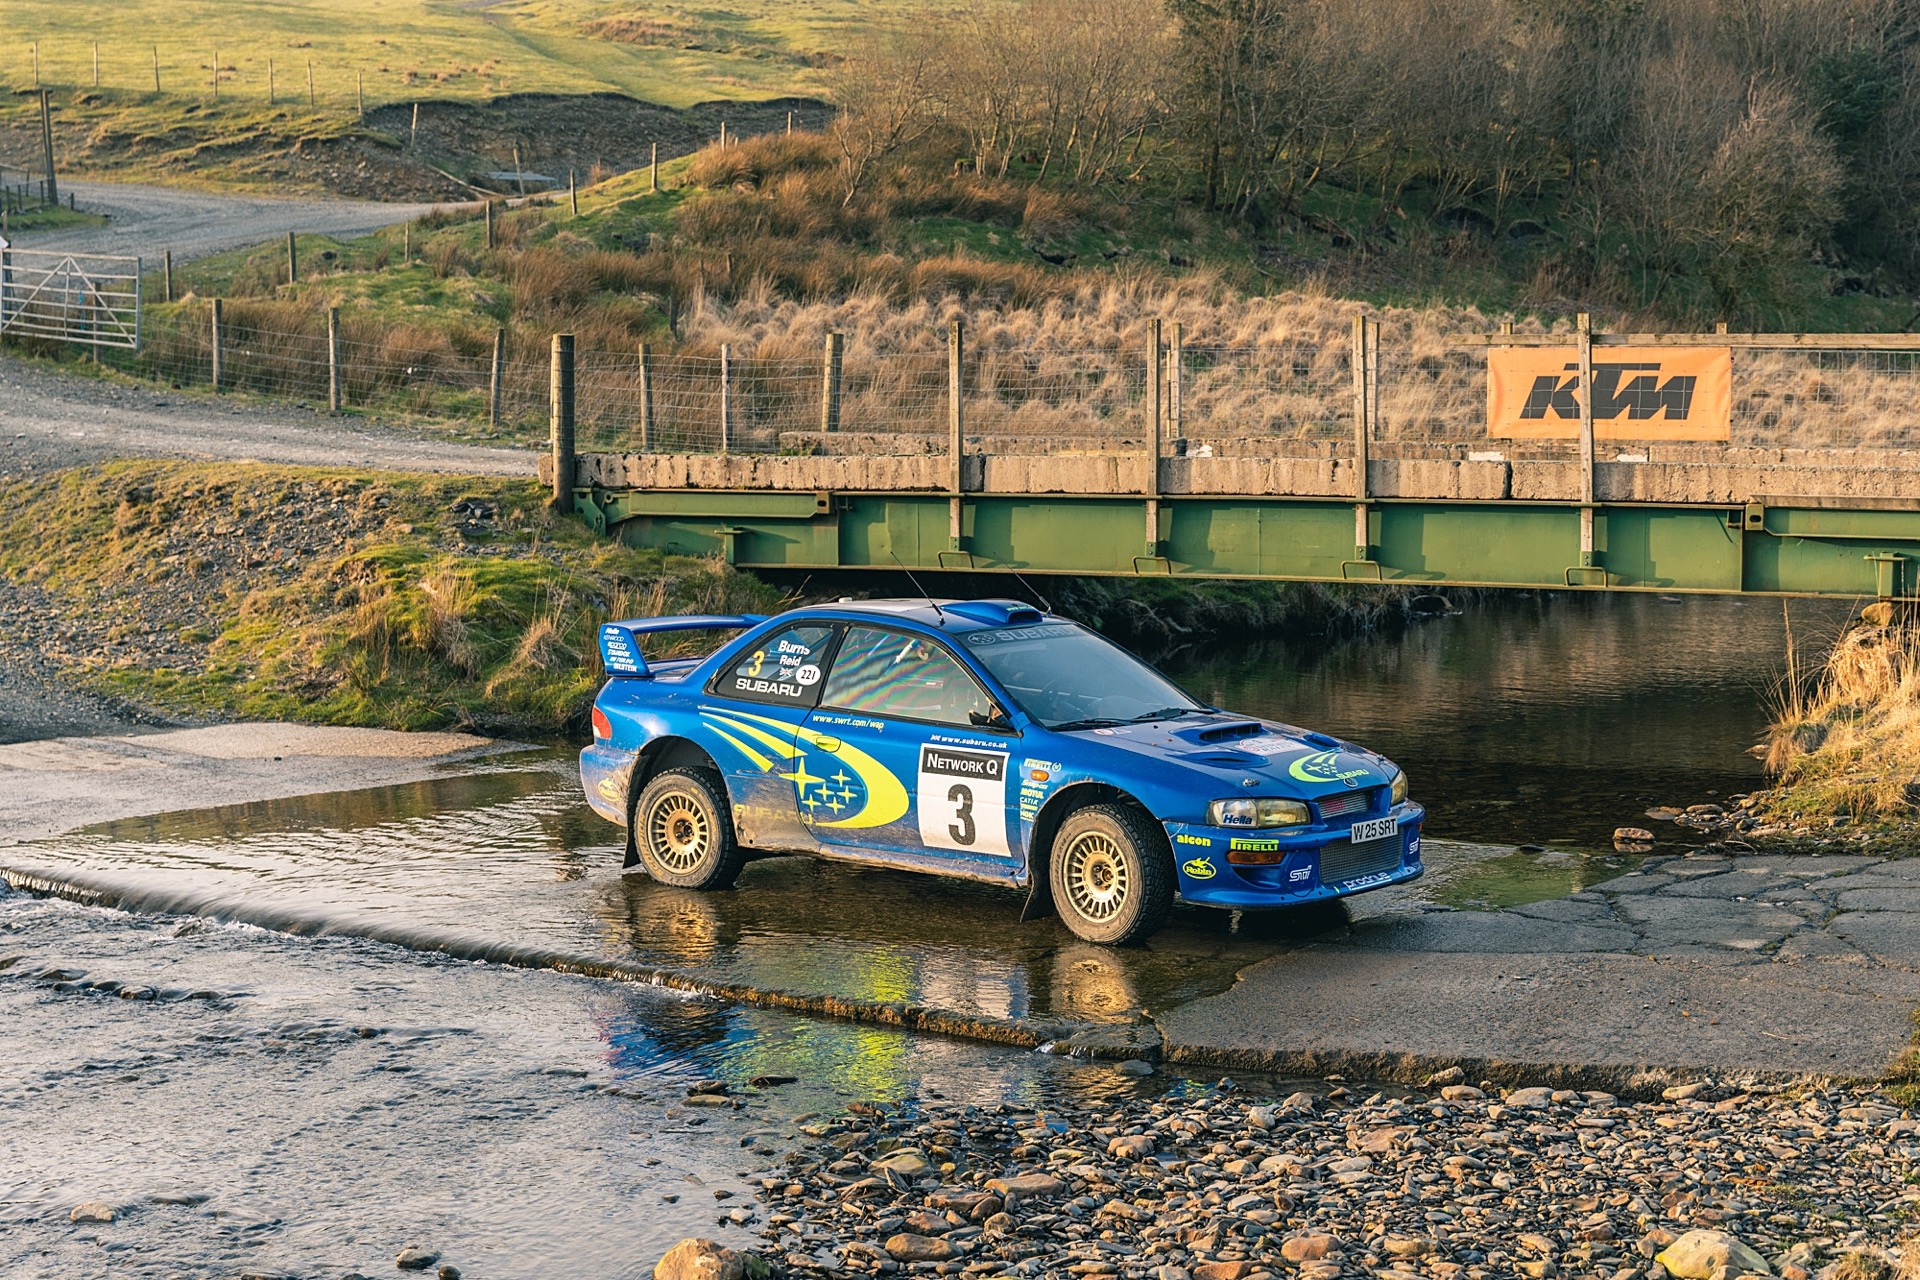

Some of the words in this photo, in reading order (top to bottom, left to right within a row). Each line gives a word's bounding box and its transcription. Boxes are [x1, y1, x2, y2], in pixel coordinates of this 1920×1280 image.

[1520, 363, 1697, 420] KTM
[995, 626, 1072, 641] SUBARU
[778, 640, 810, 655] Burns
[748, 650, 765, 677] 3
[779, 655, 802, 666] Reid
[801, 670, 816, 680] 221
[735, 678, 803, 697] SUBARU
[813, 715, 885, 730] www.swrt.com/wap
[941, 736, 1007, 748] www.subaru.co.uk
[986, 759, 998, 775] Q
[1023, 758, 1052, 770] PIRELLI
[1020, 788, 1044, 799] MOTUL
[948, 784, 976, 845] 3
[1223, 814, 1252, 825] Hella
[1353, 826, 1363, 840] W
[1365, 823, 1377, 839] 25
[1378, 819, 1396, 836] SRT
[1176, 834, 1211, 847] alcon
[1230, 838, 1280, 851] PIRELLI
[1186, 866, 1212, 876] Robin
